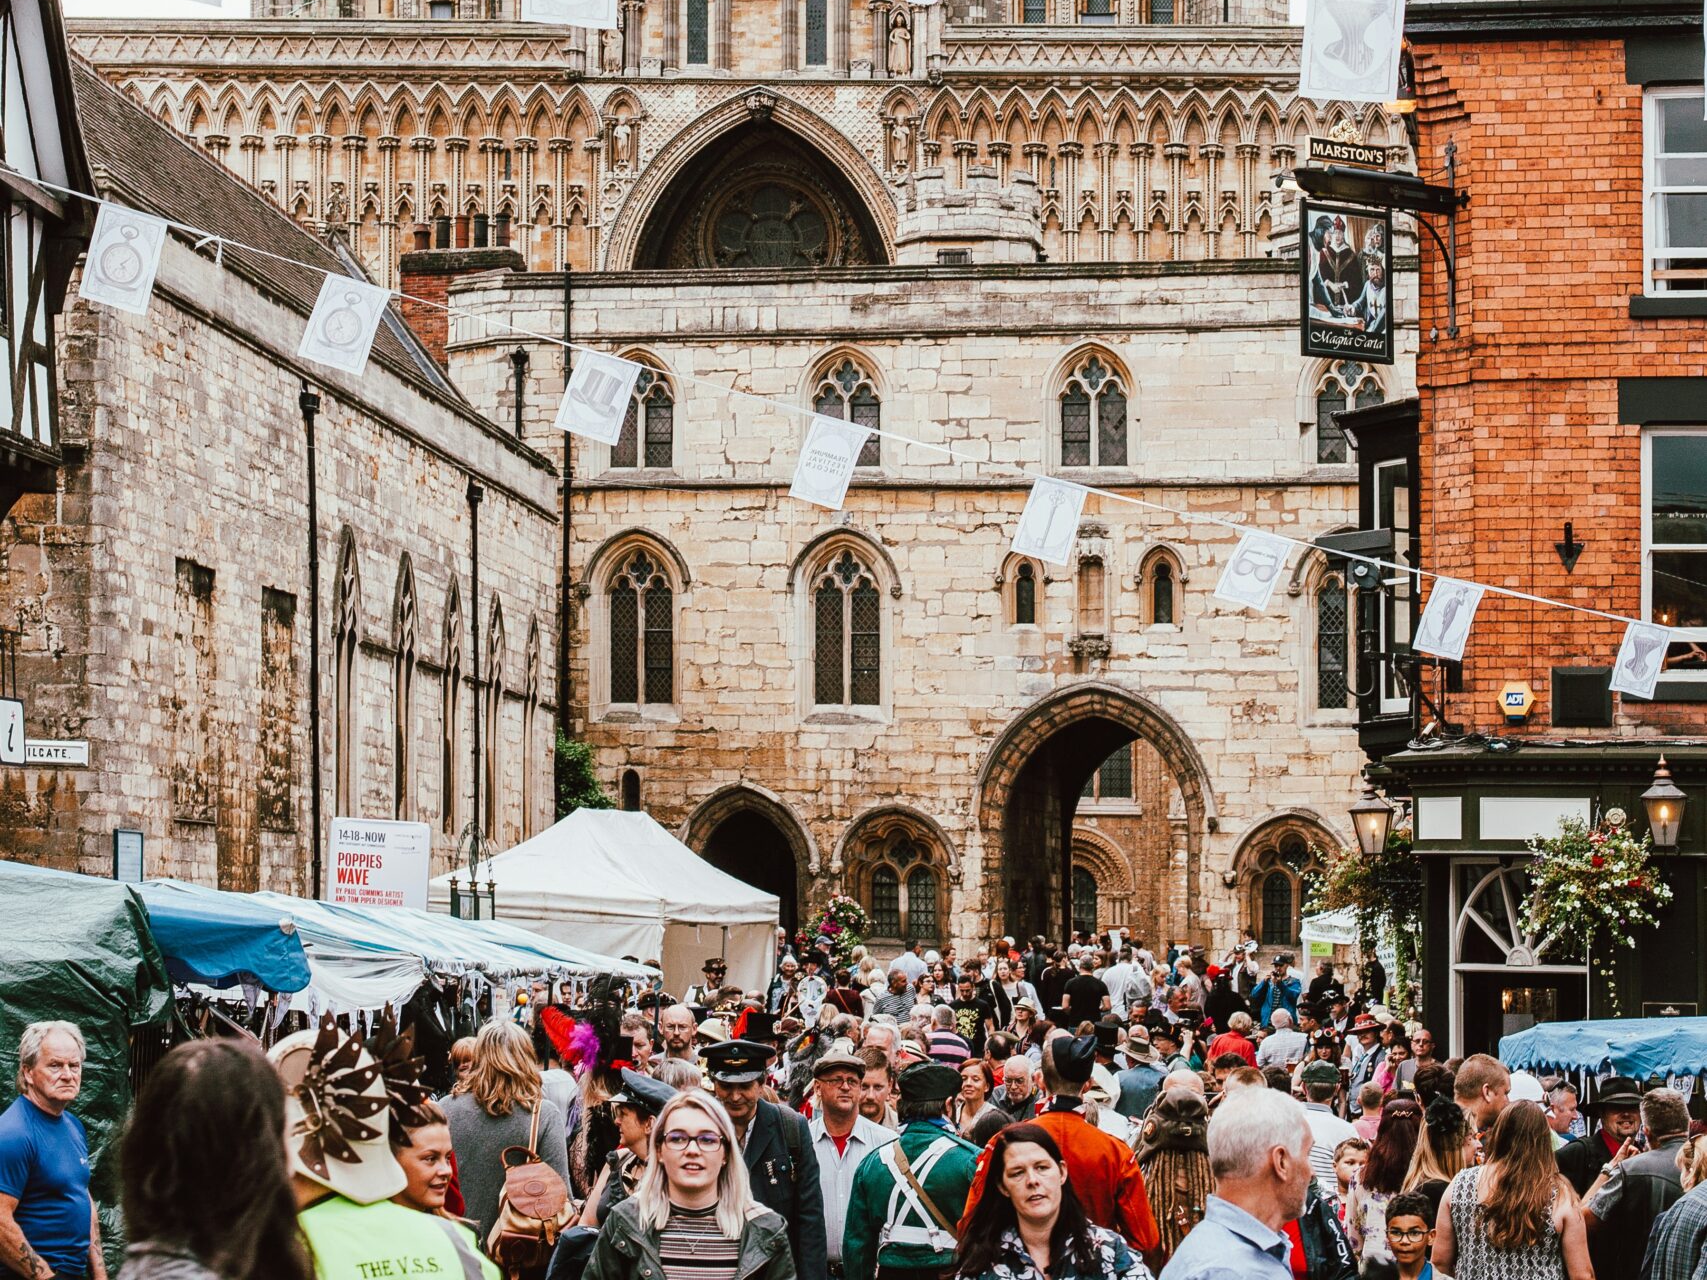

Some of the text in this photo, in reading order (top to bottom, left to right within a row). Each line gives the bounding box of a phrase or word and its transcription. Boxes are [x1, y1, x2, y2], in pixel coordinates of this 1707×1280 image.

[1312, 142, 1384, 164] MARSTON'S
[1310, 329, 1385, 350] Magna Carta
[1506, 694, 1524, 705] ADT
[337, 852, 383, 869] POPPIES
[337, 867, 370, 886] WAVE
[335, 895, 403, 907] AND TOM PIPER DESIGNER
[359, 889, 384, 897] CUMMINS
[385, 891, 404, 899] ARTIST
[356, 1260, 394, 1279] THE
